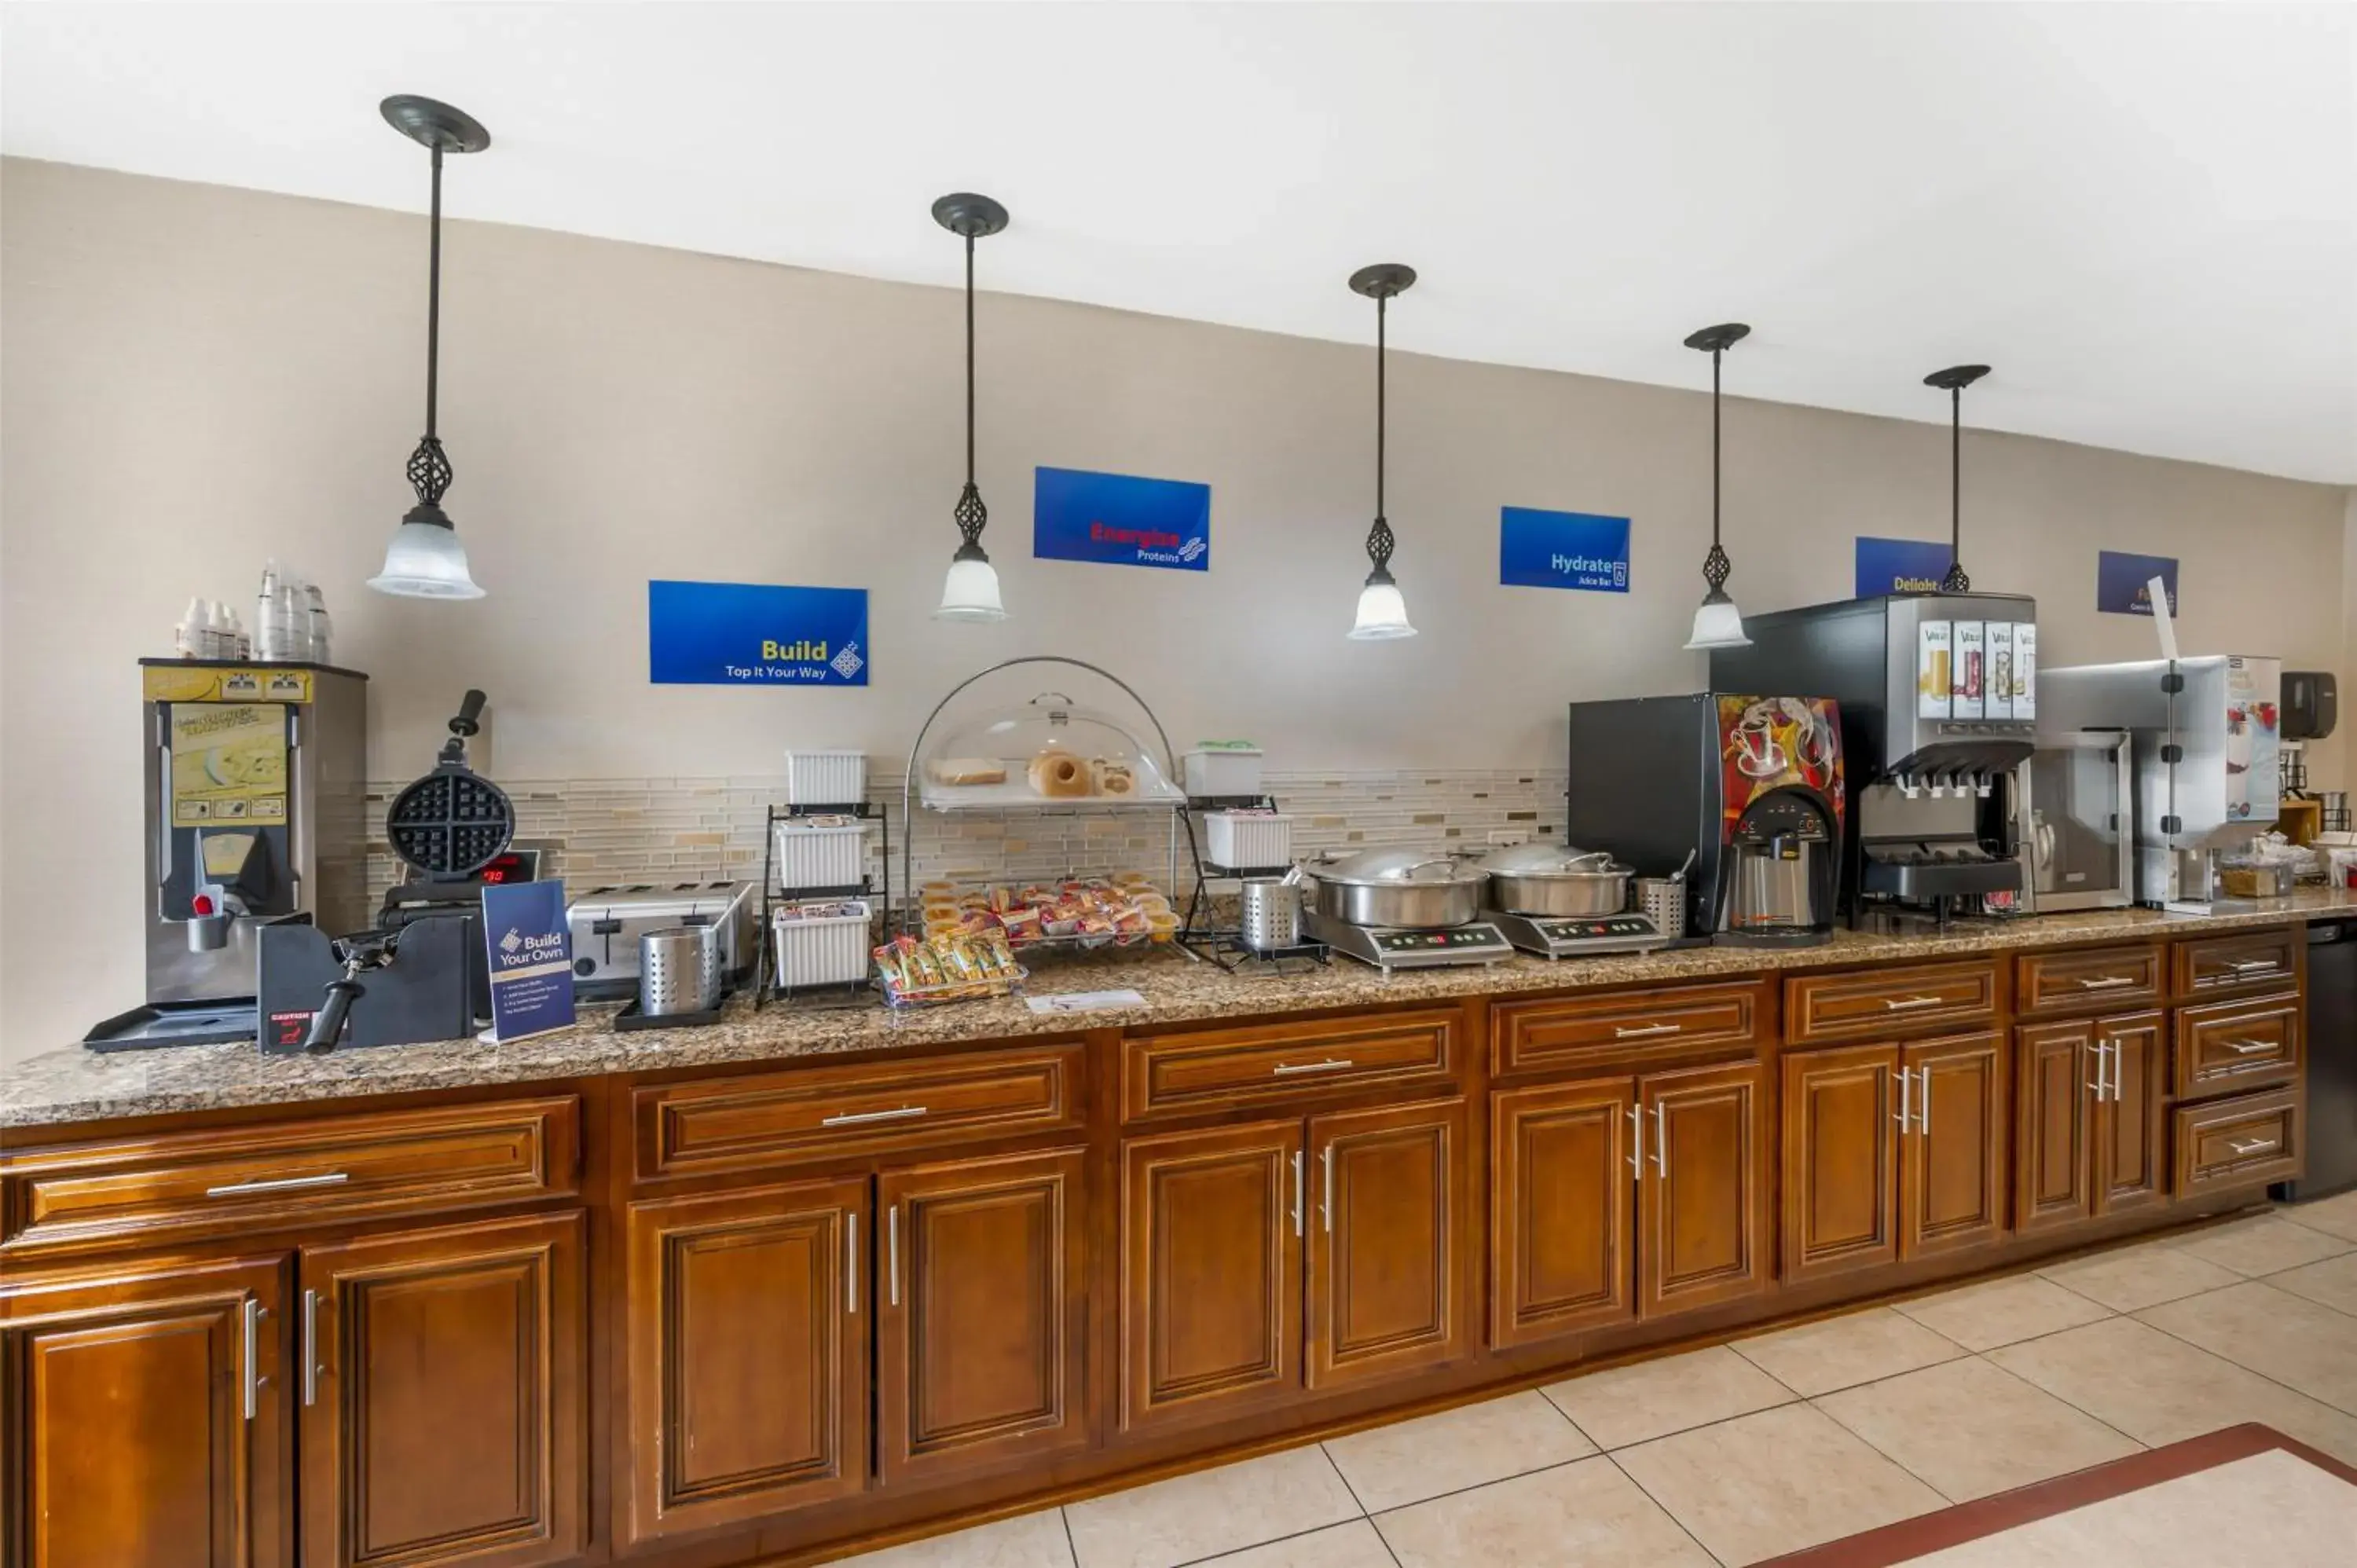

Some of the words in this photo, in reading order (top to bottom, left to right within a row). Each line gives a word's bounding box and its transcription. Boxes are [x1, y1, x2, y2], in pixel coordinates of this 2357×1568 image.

[1137, 549, 1179, 562] Proteins
[1552, 553, 1612, 573] Hydrate
[762, 640, 827, 661] Build
[726, 665, 751, 679] Top
[753, 666, 764, 677] It
[767, 666, 797, 678] Your
[799, 666, 827, 680] Way
[524, 932, 562, 950] Build
[500, 952, 530, 965] Your
[532, 948, 563, 962] Own
[271, 1012, 310, 1020] CAUTION
